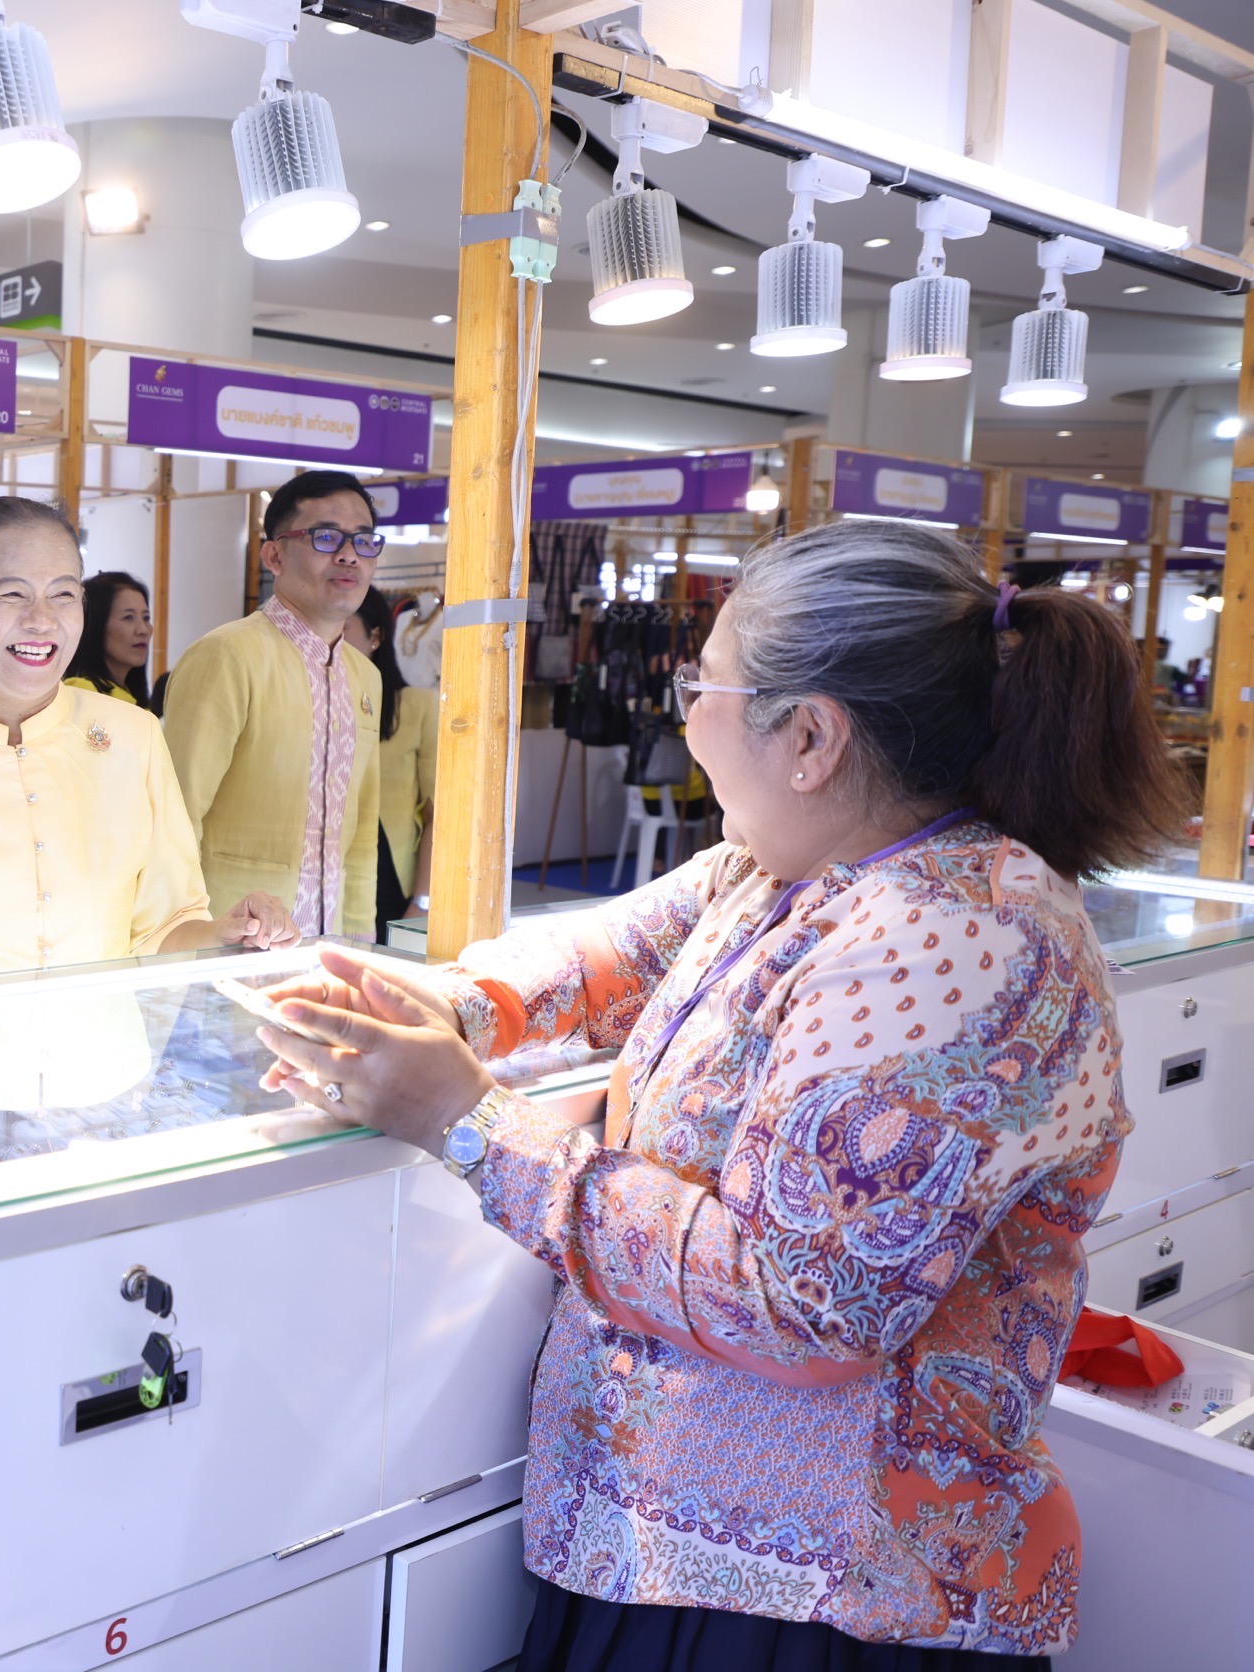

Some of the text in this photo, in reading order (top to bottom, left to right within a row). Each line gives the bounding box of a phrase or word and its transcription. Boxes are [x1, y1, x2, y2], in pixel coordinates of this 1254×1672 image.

[413, 452, 424, 465] 21
[1160, 1199, 1169, 1220] 4
[105, 1617, 128, 1655] 6
